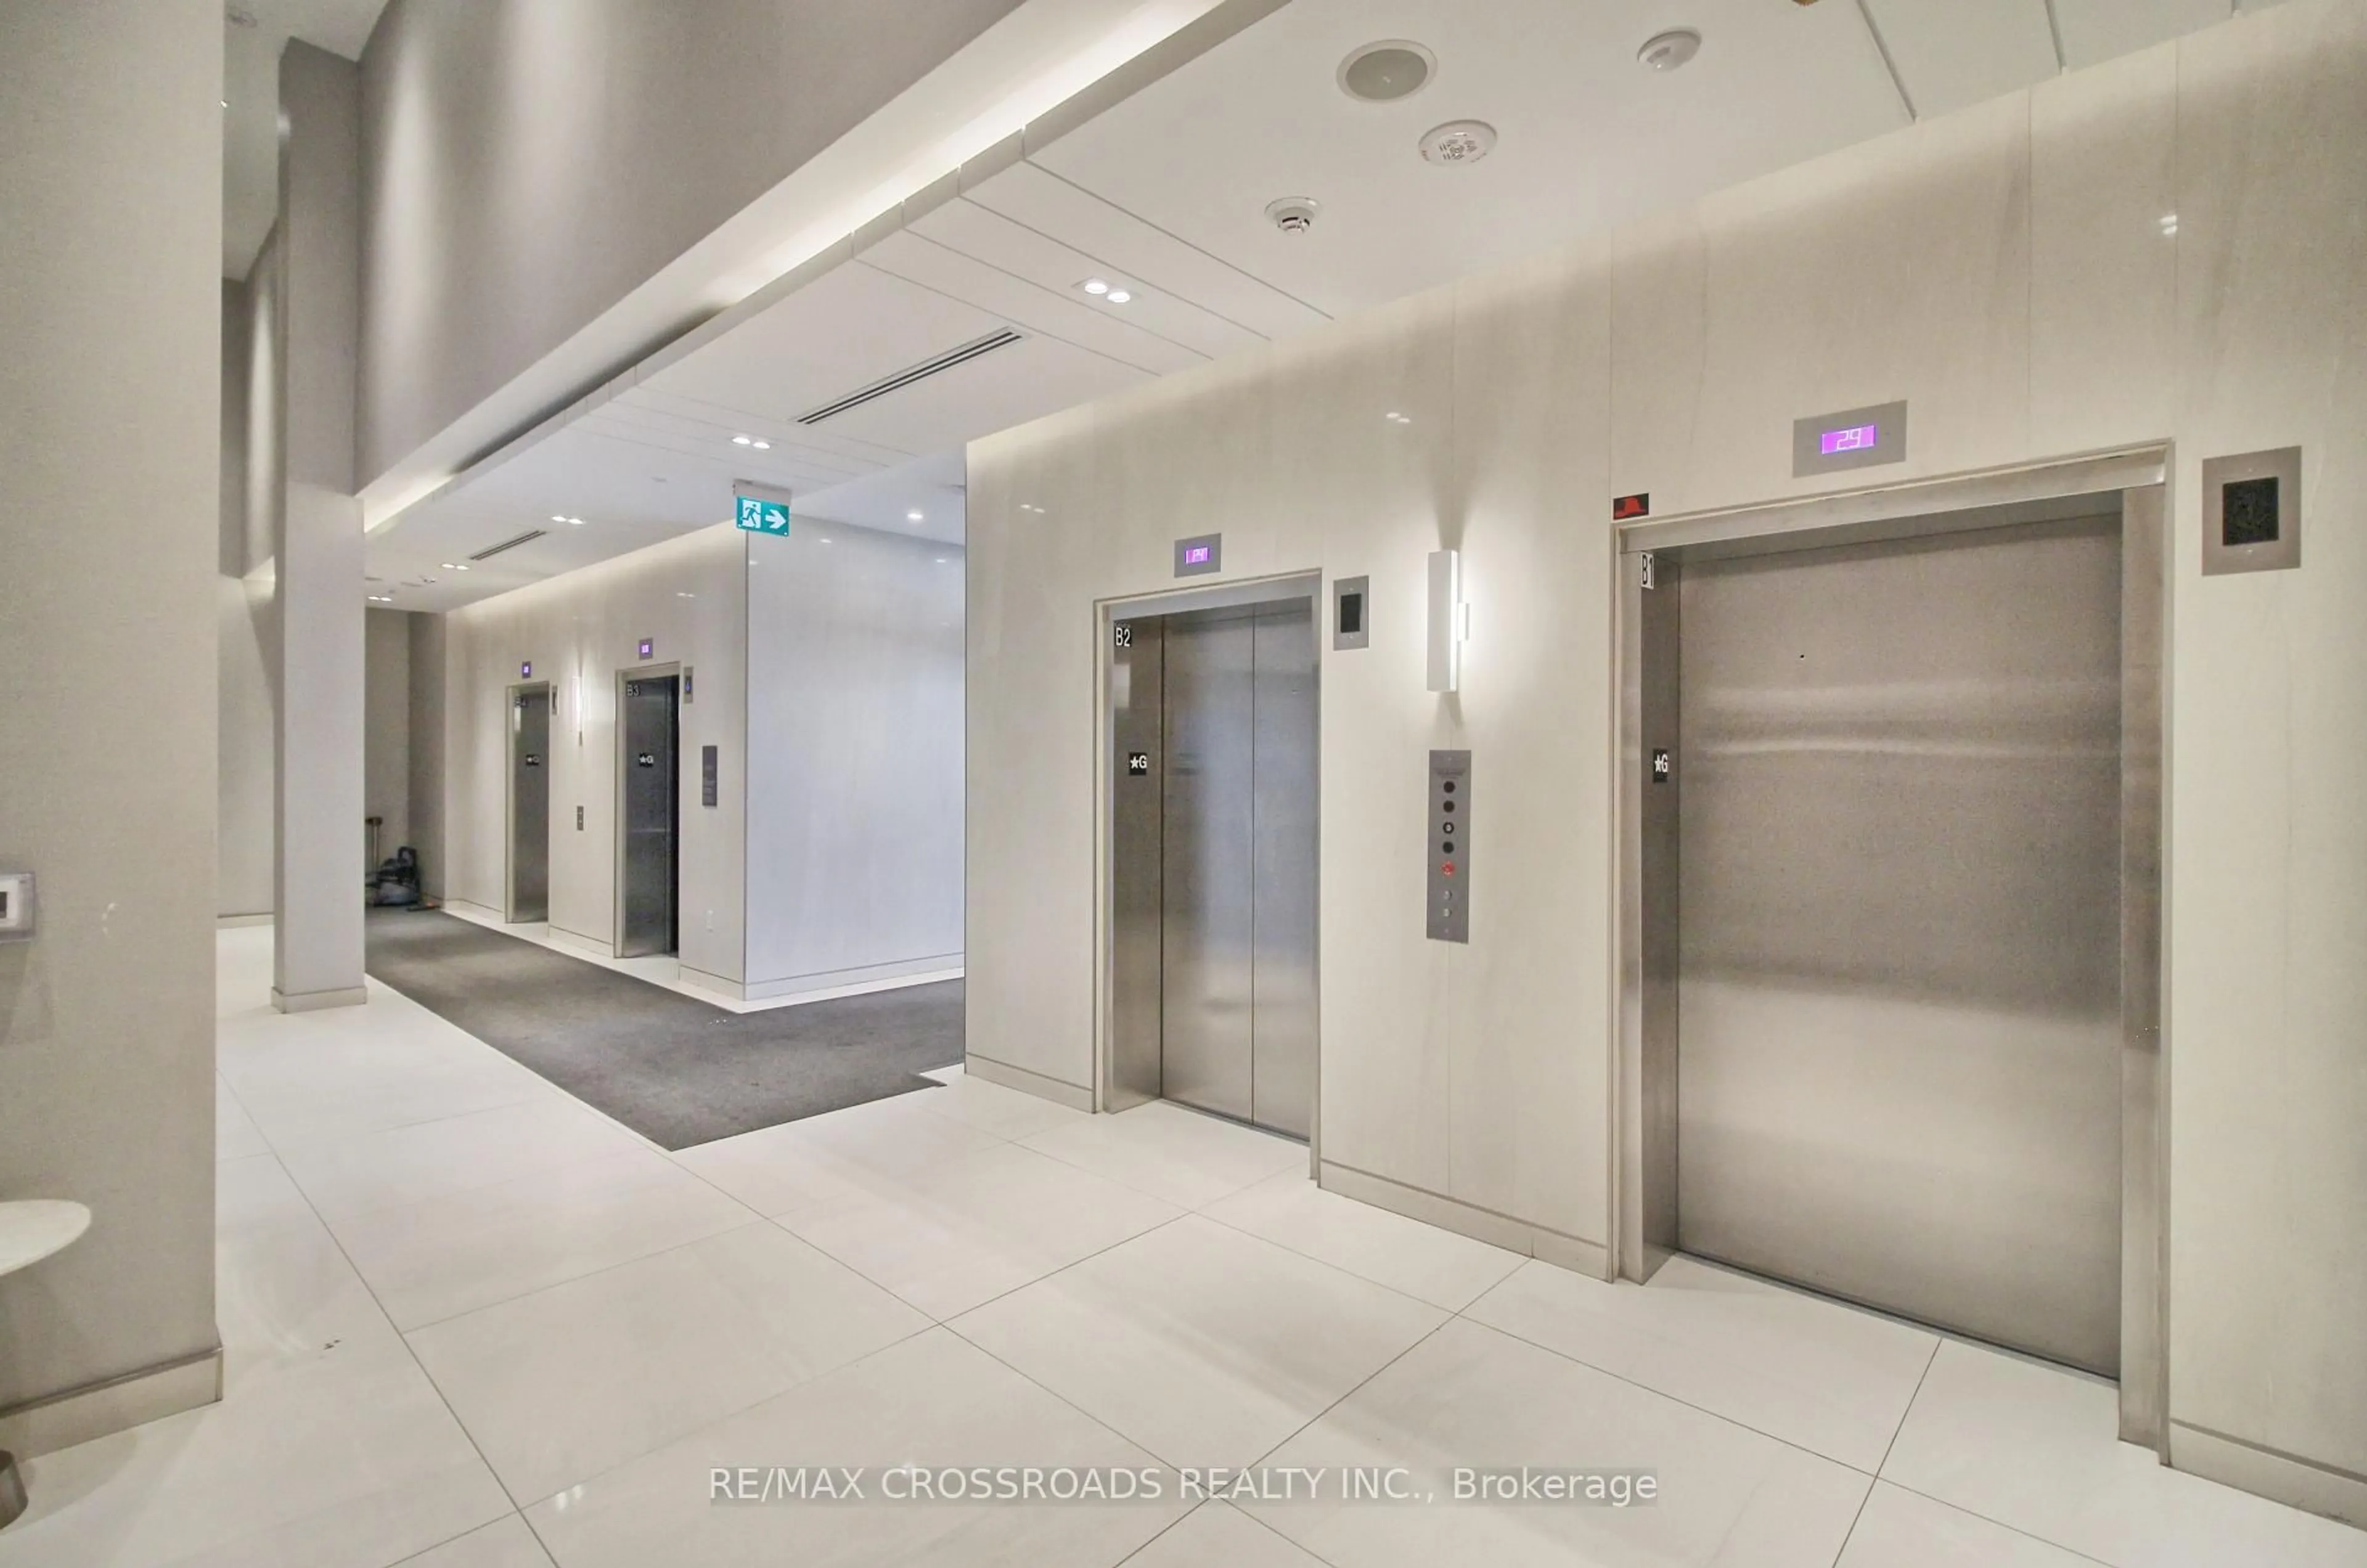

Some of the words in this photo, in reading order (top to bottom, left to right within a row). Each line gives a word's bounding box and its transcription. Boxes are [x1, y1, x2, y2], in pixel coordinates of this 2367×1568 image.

[1836, 428, 1861, 450] 29
[1641, 554, 1653, 587] B1
[1115, 627, 1130, 647] B2
